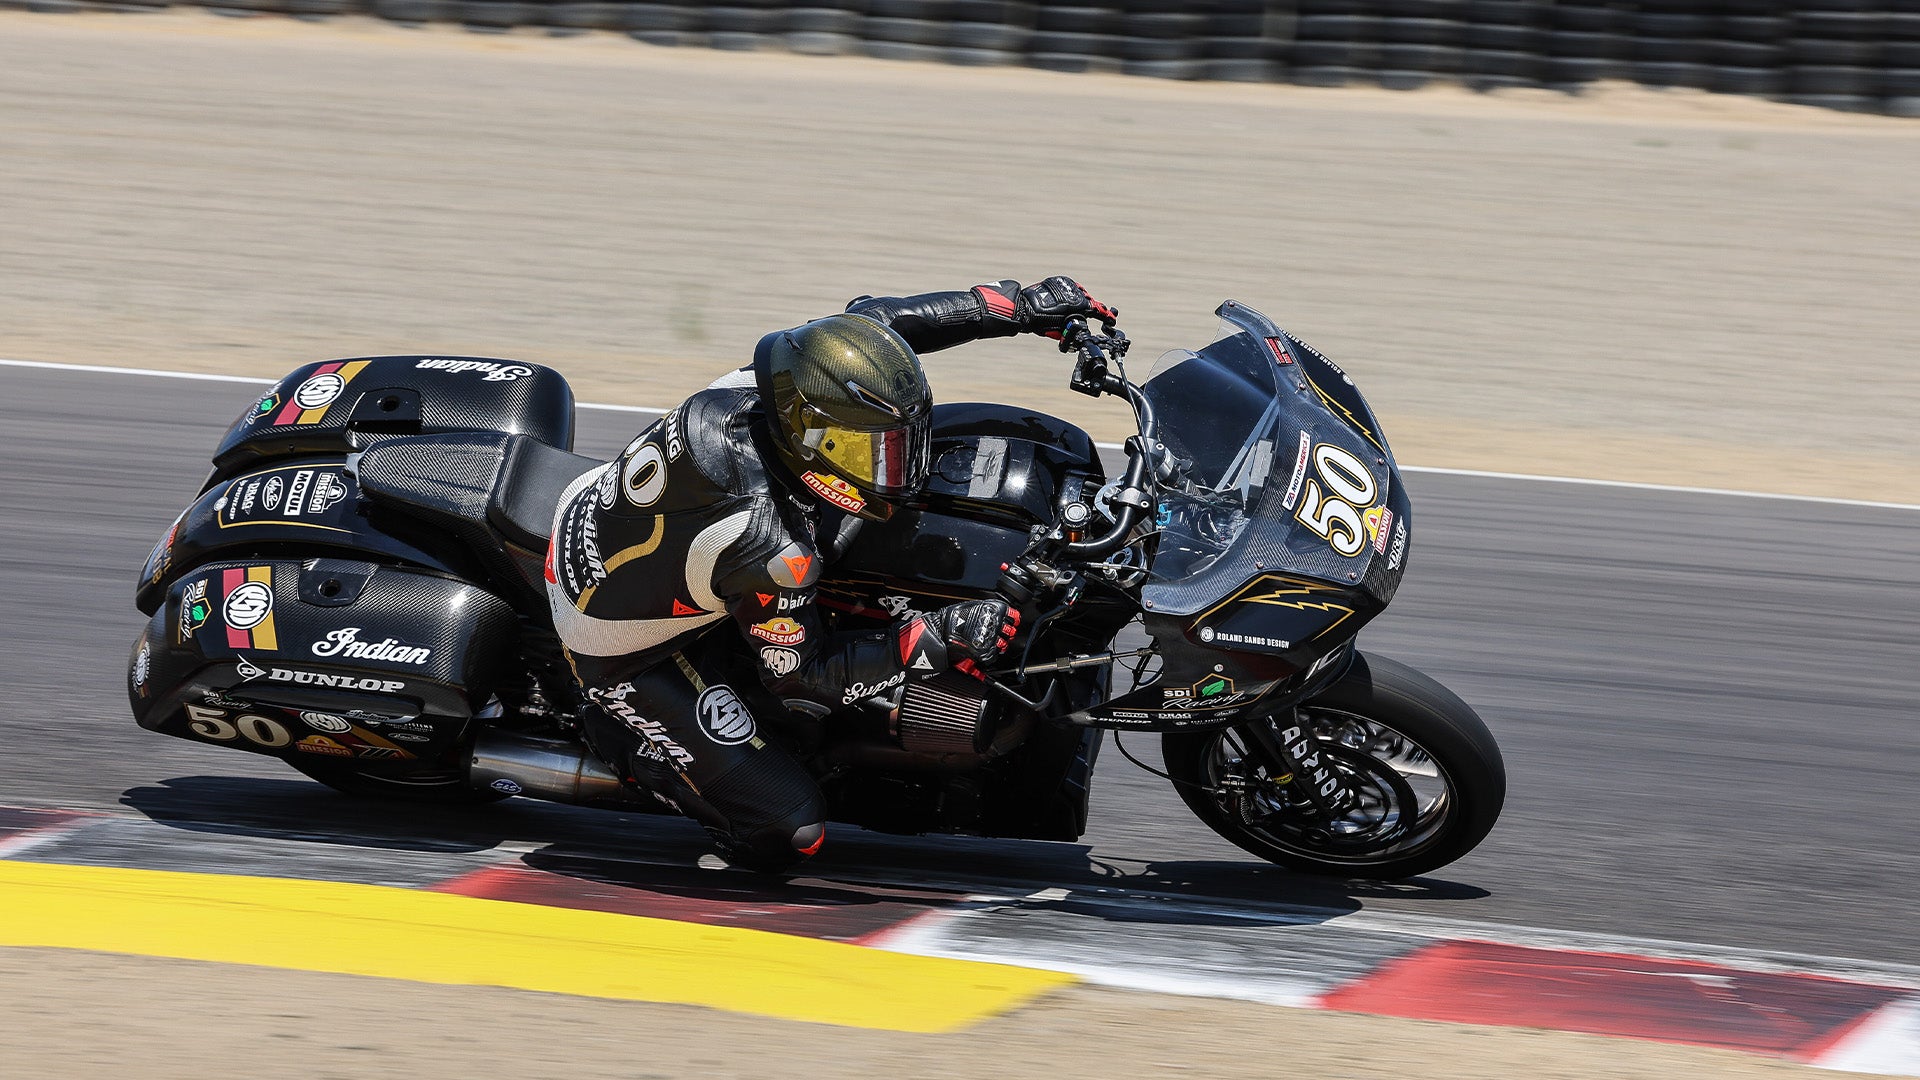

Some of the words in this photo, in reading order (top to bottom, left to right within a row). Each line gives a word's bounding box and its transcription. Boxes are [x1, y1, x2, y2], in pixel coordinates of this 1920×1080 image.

[415, 358, 533, 382] Indian
[229, 485, 243, 520] DUNLOP
[286, 472, 309, 514] MOTUL
[1295, 442, 1378, 557] 50
[564, 503, 581, 595] DUNLOP
[194, 578, 206, 599] SDI
[180, 582, 196, 638] Racing
[311, 627, 431, 665] Indian
[1216, 631, 1243, 643] ROLAND
[1244, 635, 1266, 646] SANDS
[1266, 638, 1290, 649] DESIGN
[763, 648, 797, 675] RSD
[268, 668, 405, 693] DUNLOP
[1163, 689, 1191, 697] SDI
[1162, 690, 1244, 710] Racing
[185, 703, 292, 747] 50
[303, 712, 349, 733] RSD
[588, 681, 696, 768] Indian
[1281, 726, 1346, 810] DUNLOP
